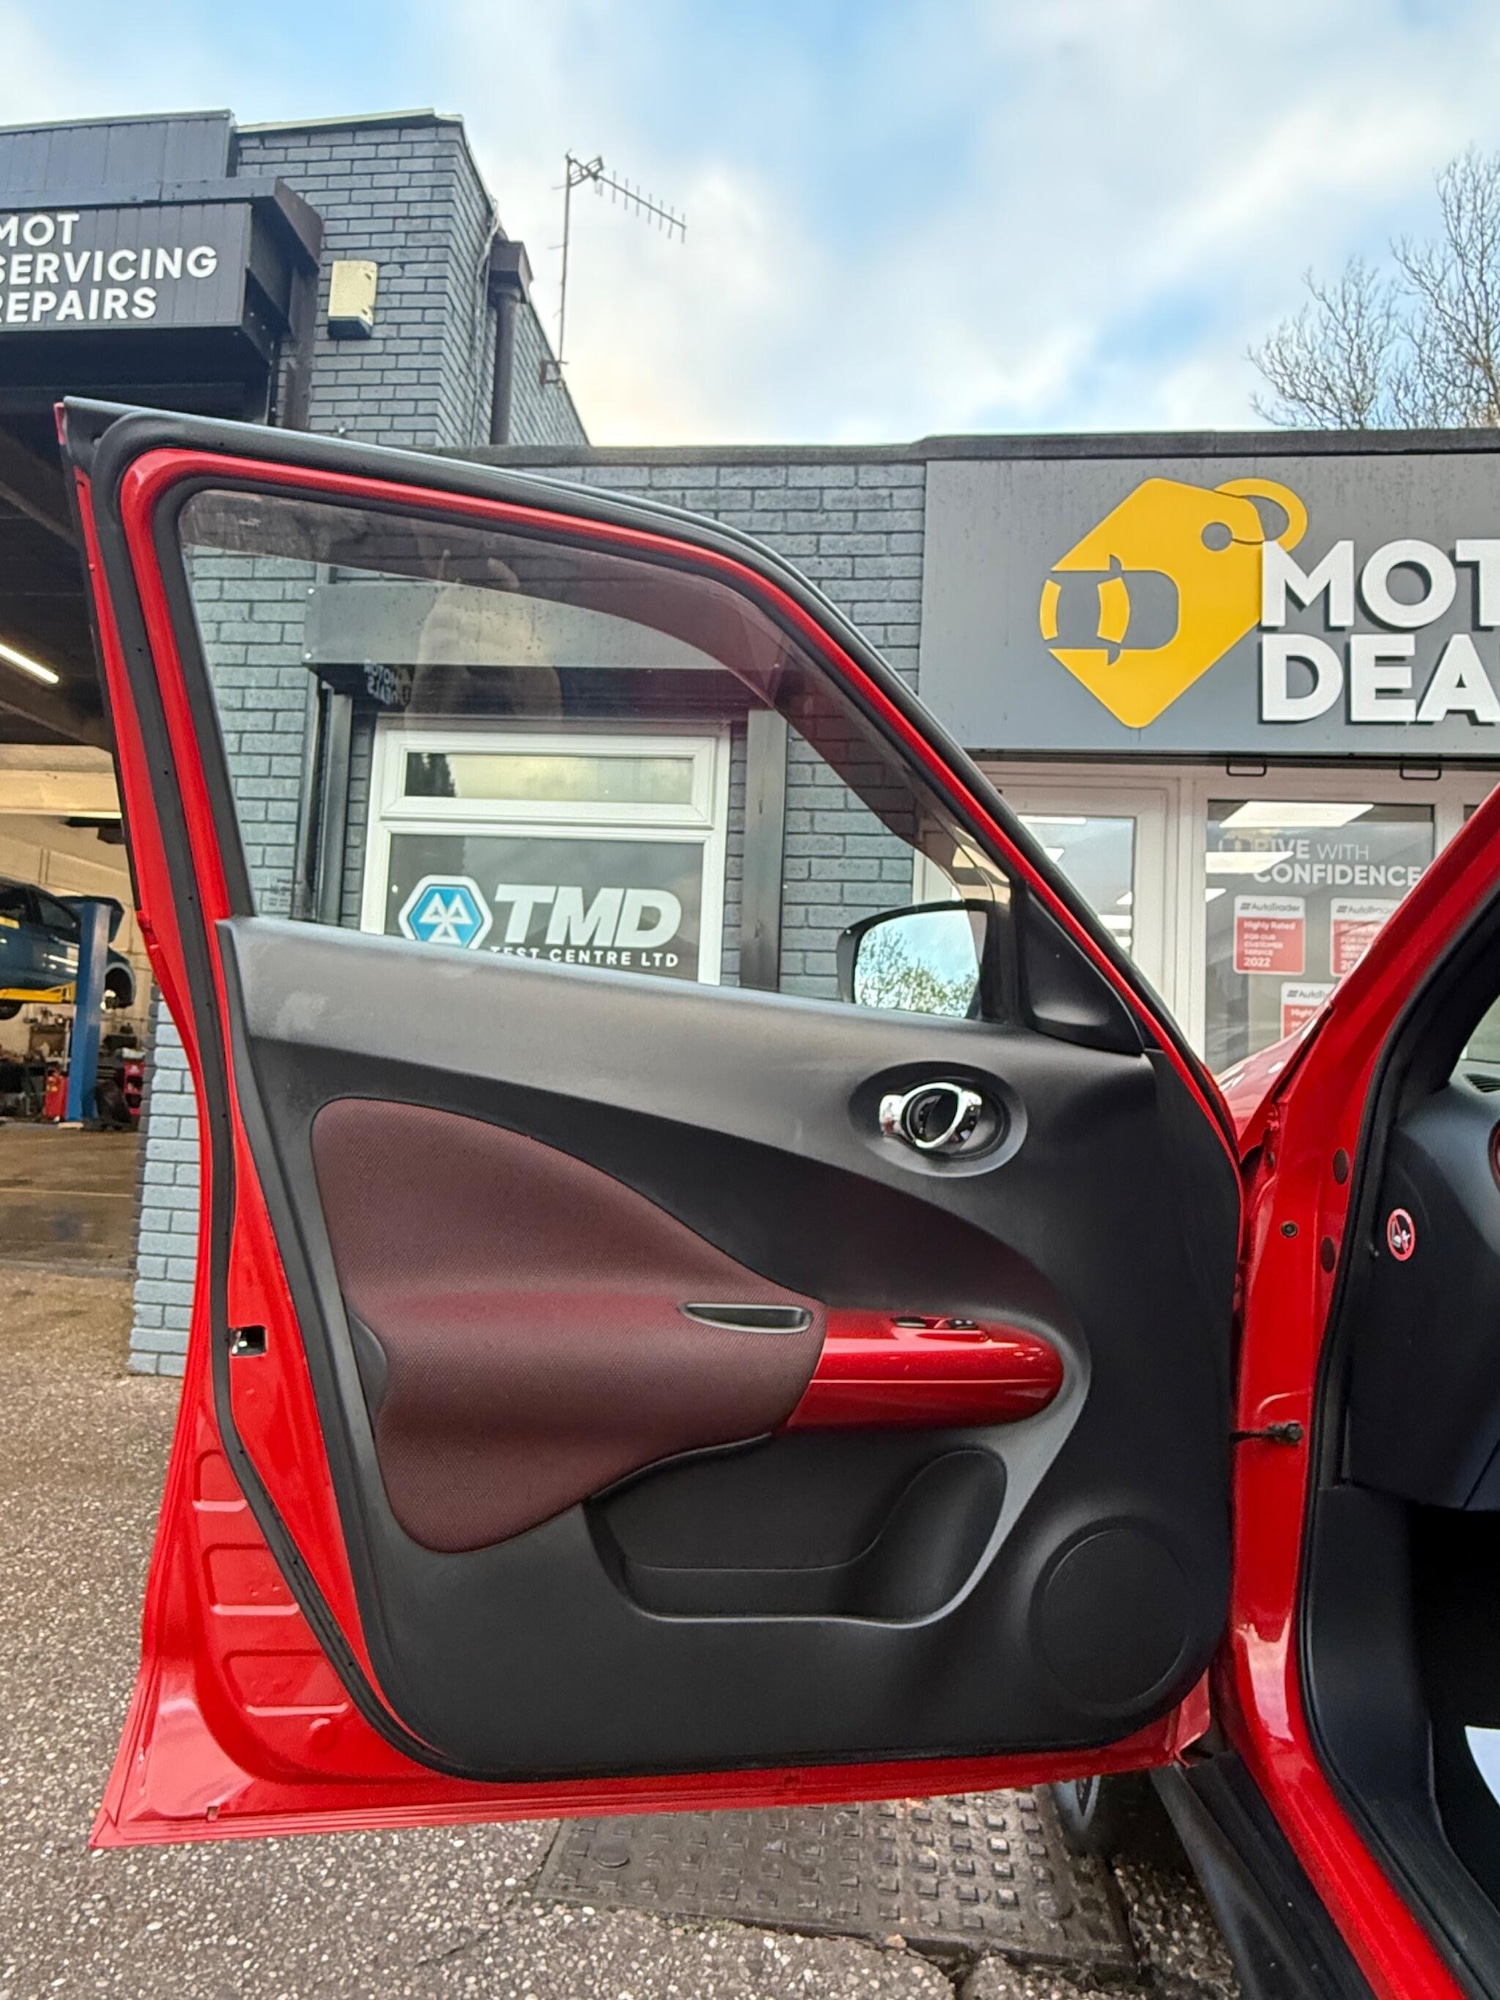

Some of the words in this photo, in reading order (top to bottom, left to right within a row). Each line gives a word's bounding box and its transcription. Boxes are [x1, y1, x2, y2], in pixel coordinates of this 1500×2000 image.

[0, 246, 218, 285] ERVICING
[0, 286, 157, 324] EPAIRS
[1316, 843, 1370, 861] WITH
[495, 884, 682, 949] TMD
[549, 948, 632, 966] CENTRE
[640, 952, 680, 969] LTD
[1243, 957, 1272, 969] 2022
